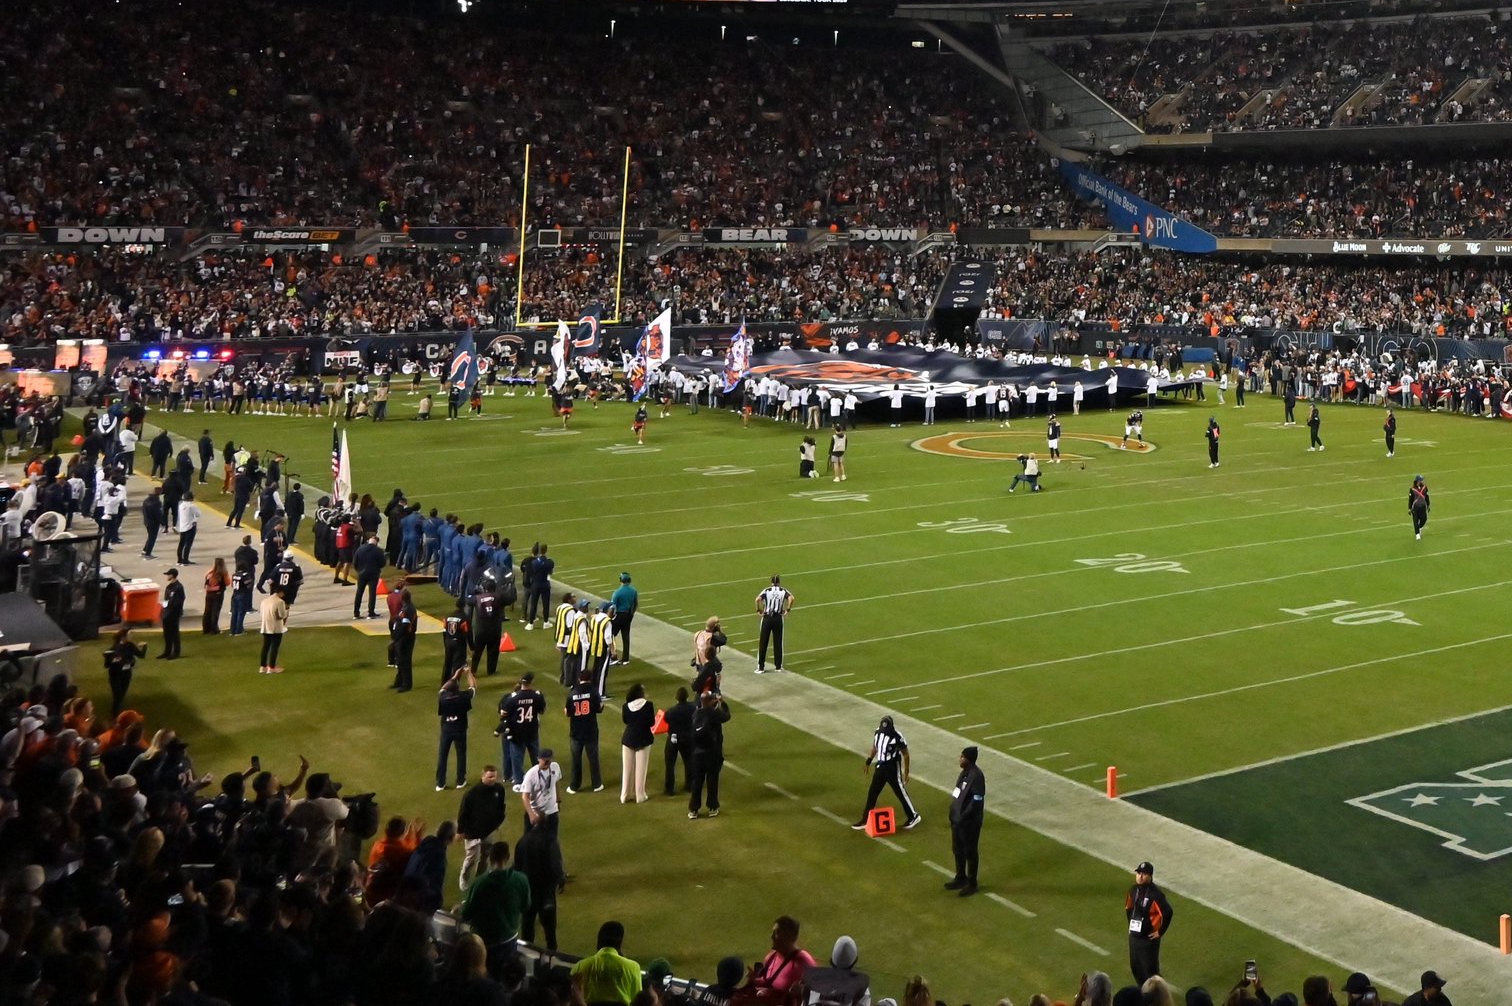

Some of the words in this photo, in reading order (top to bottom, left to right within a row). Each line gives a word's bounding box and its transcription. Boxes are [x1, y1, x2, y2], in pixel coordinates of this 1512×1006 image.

[1096, 180, 1108, 196] Bank
[1108, 188, 1114, 201] of
[1122, 196, 1139, 216] Bears
[58, 228, 165, 242] DOWN
[253, 231, 309, 240] theScore
[721, 230, 788, 241] BEAR
[850, 230, 917, 241] DOWN
[1156, 217, 1178, 239] PNC
[1350, 243, 1366, 251] MOON
[1392, 243, 1424, 253] Advocate
[1075, 553, 1177, 575] 20
[280, 573, 290, 585] 18
[1279, 599, 1406, 626] 10
[517, 706, 533, 724] 34
[574, 700, 590, 716] 18
[875, 811, 890, 834] G
